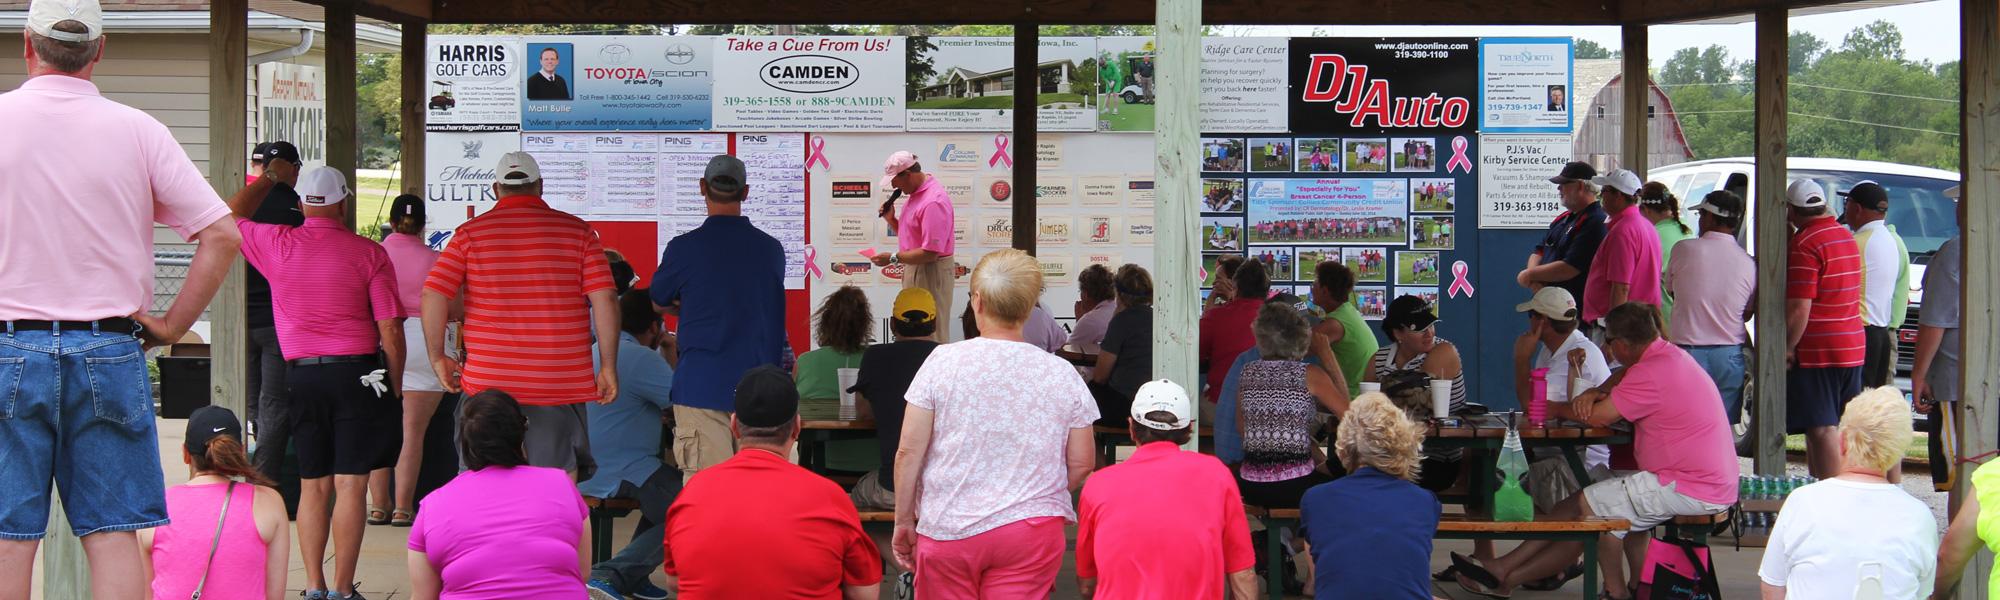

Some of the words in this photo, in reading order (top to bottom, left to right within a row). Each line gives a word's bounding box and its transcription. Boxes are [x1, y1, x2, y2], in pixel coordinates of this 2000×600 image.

[727, 38, 763, 51] Take
[768, 38, 778, 51] a
[782, 38, 814, 51] Cue
[818, 38, 858, 51] From
[864, 38, 891, 51] Us!
[938, 39, 972, 48] Premier
[975, 39, 1014, 48] Investme
[1062, 39, 1078, 48] Inc.
[440, 45, 505, 62] HARRIS
[1205, 44, 1230, 56] Ridge
[1233, 44, 1254, 56] Care
[1256, 44, 1286, 56] Center
[436, 64, 468, 76] GOLF
[472, 64, 506, 76] CARS
[769, 66, 848, 78] CAMDEN
[650, 79, 662, 87] City
[723, 97, 792, 106] 319-365-1558
[811, 97, 896, 106] 888-9CAMDEN
[300, 107, 322, 161] GOLF
[1526, 145, 1542, 154] Vac
[1484, 156, 1506, 166] Kirby
[1508, 156, 1540, 166] Service
[1542, 156, 1570, 166] Center
[440, 166, 496, 182] Michelo
[428, 184, 498, 202] ULTR
[1494, 202, 1558, 212] 319-363-9184
